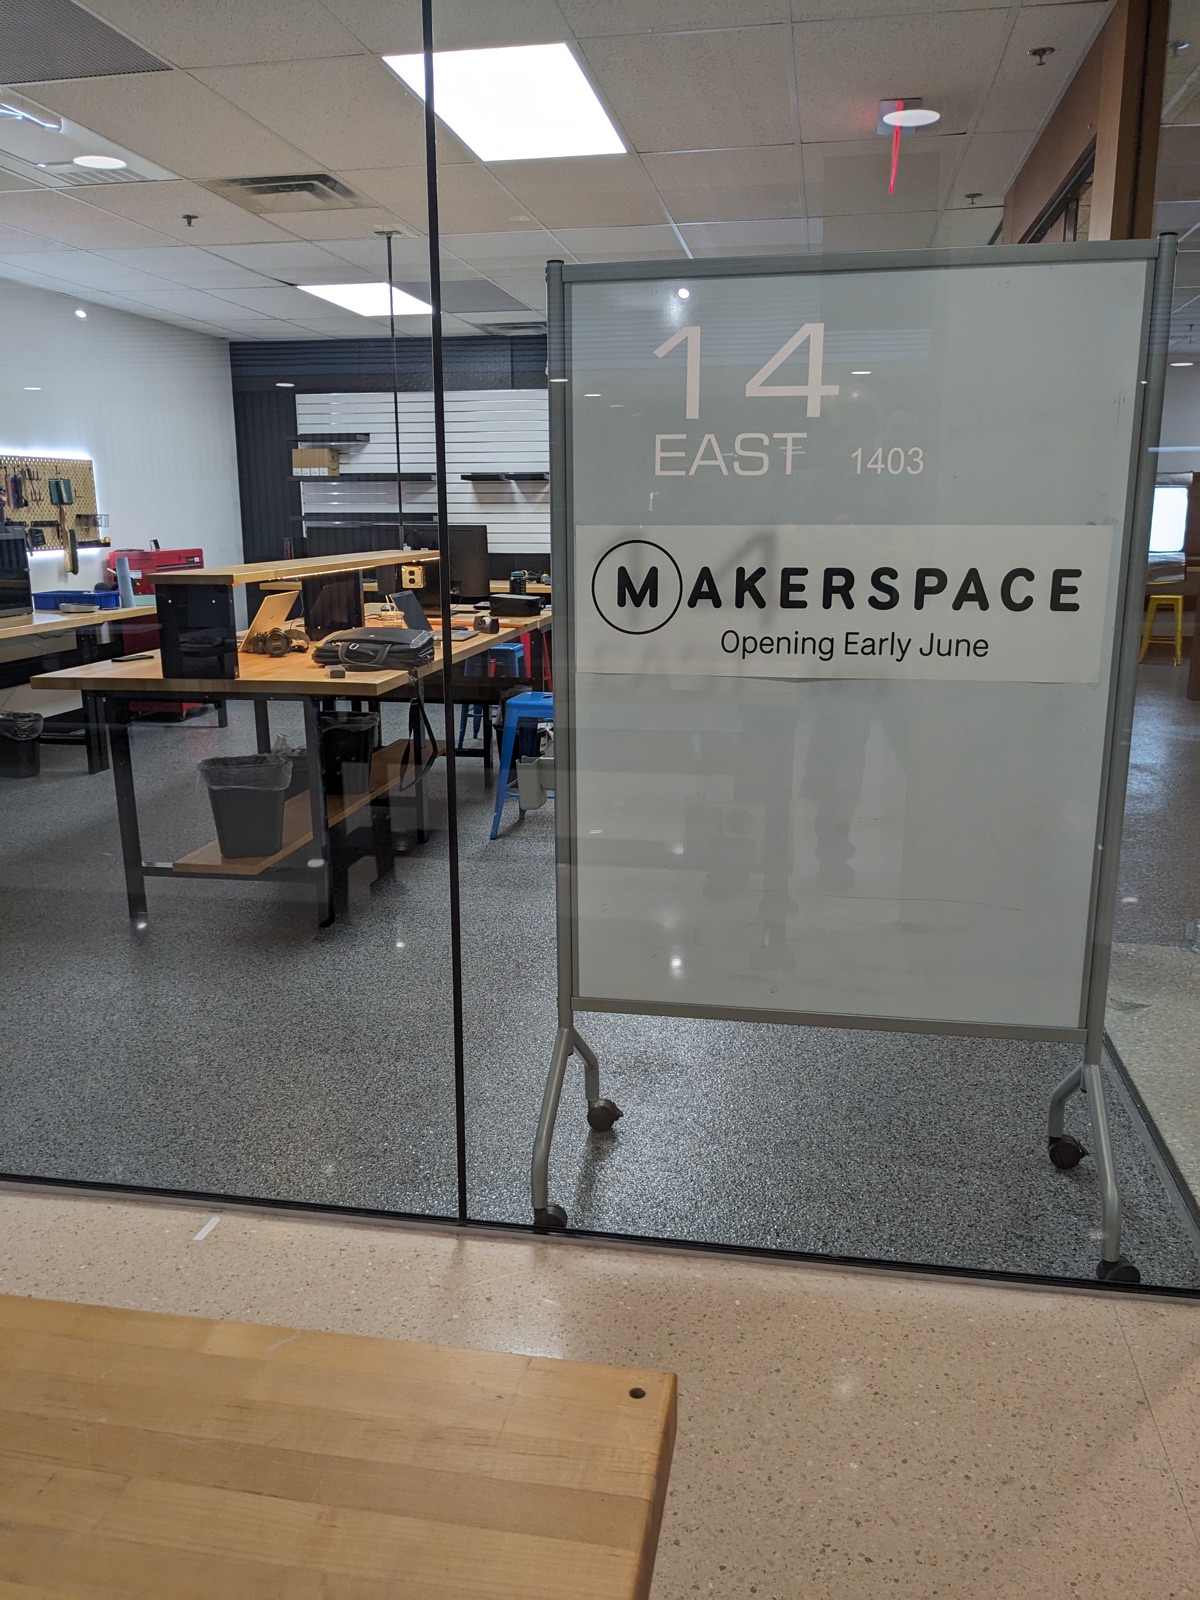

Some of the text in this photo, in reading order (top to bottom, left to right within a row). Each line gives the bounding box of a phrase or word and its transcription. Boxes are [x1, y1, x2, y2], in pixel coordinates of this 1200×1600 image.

[653, 322, 840, 419] 14
[654, 432, 807, 476] EAST
[851, 447, 924, 475] 1403
[617, 566, 1082, 612] MAKERSPACE
[720, 630, 989, 662] Opening Early June
